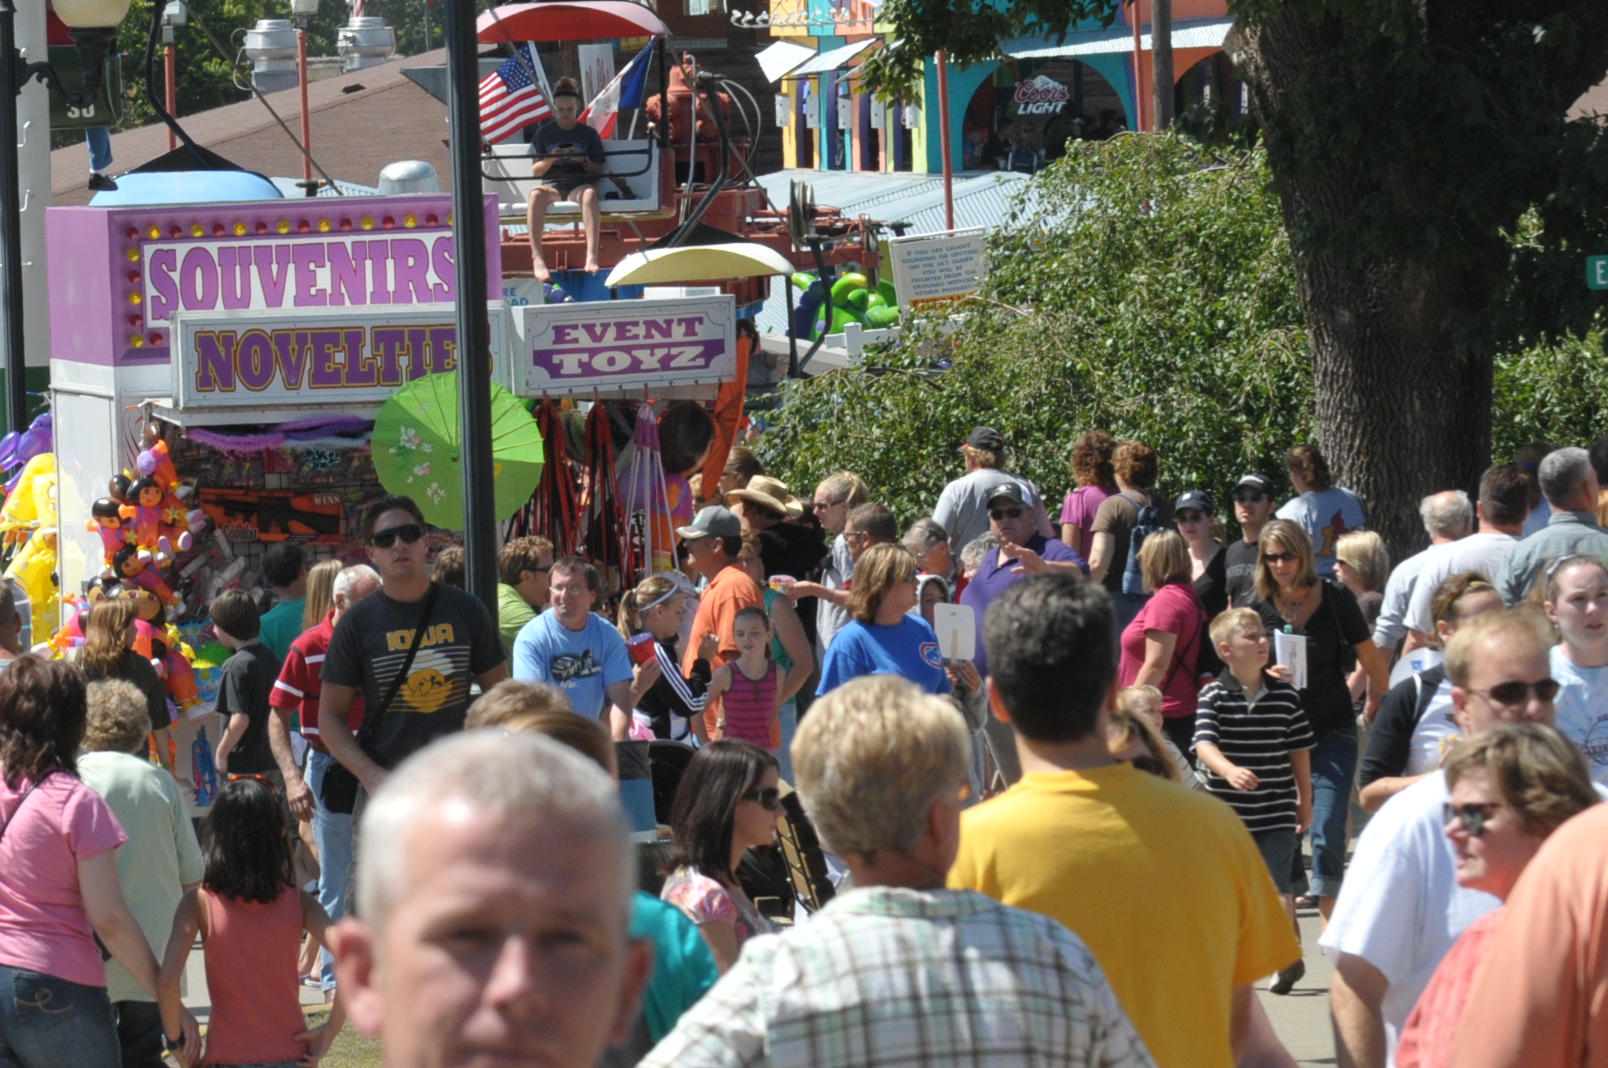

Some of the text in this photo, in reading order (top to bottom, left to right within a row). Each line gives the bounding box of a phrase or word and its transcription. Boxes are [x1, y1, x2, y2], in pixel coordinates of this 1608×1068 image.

[1014, 79, 1070, 103] Coors
[1017, 101, 1068, 115] LIGHT
[149, 236, 455, 321] SOUVENIRS
[552, 316, 704, 345] EVENT
[195, 323, 458, 392] NOVELTIE
[552, 345, 705, 375] TOYZ
[222, 524, 259, 541] Combat
[386, 623, 455, 652] IOWA
